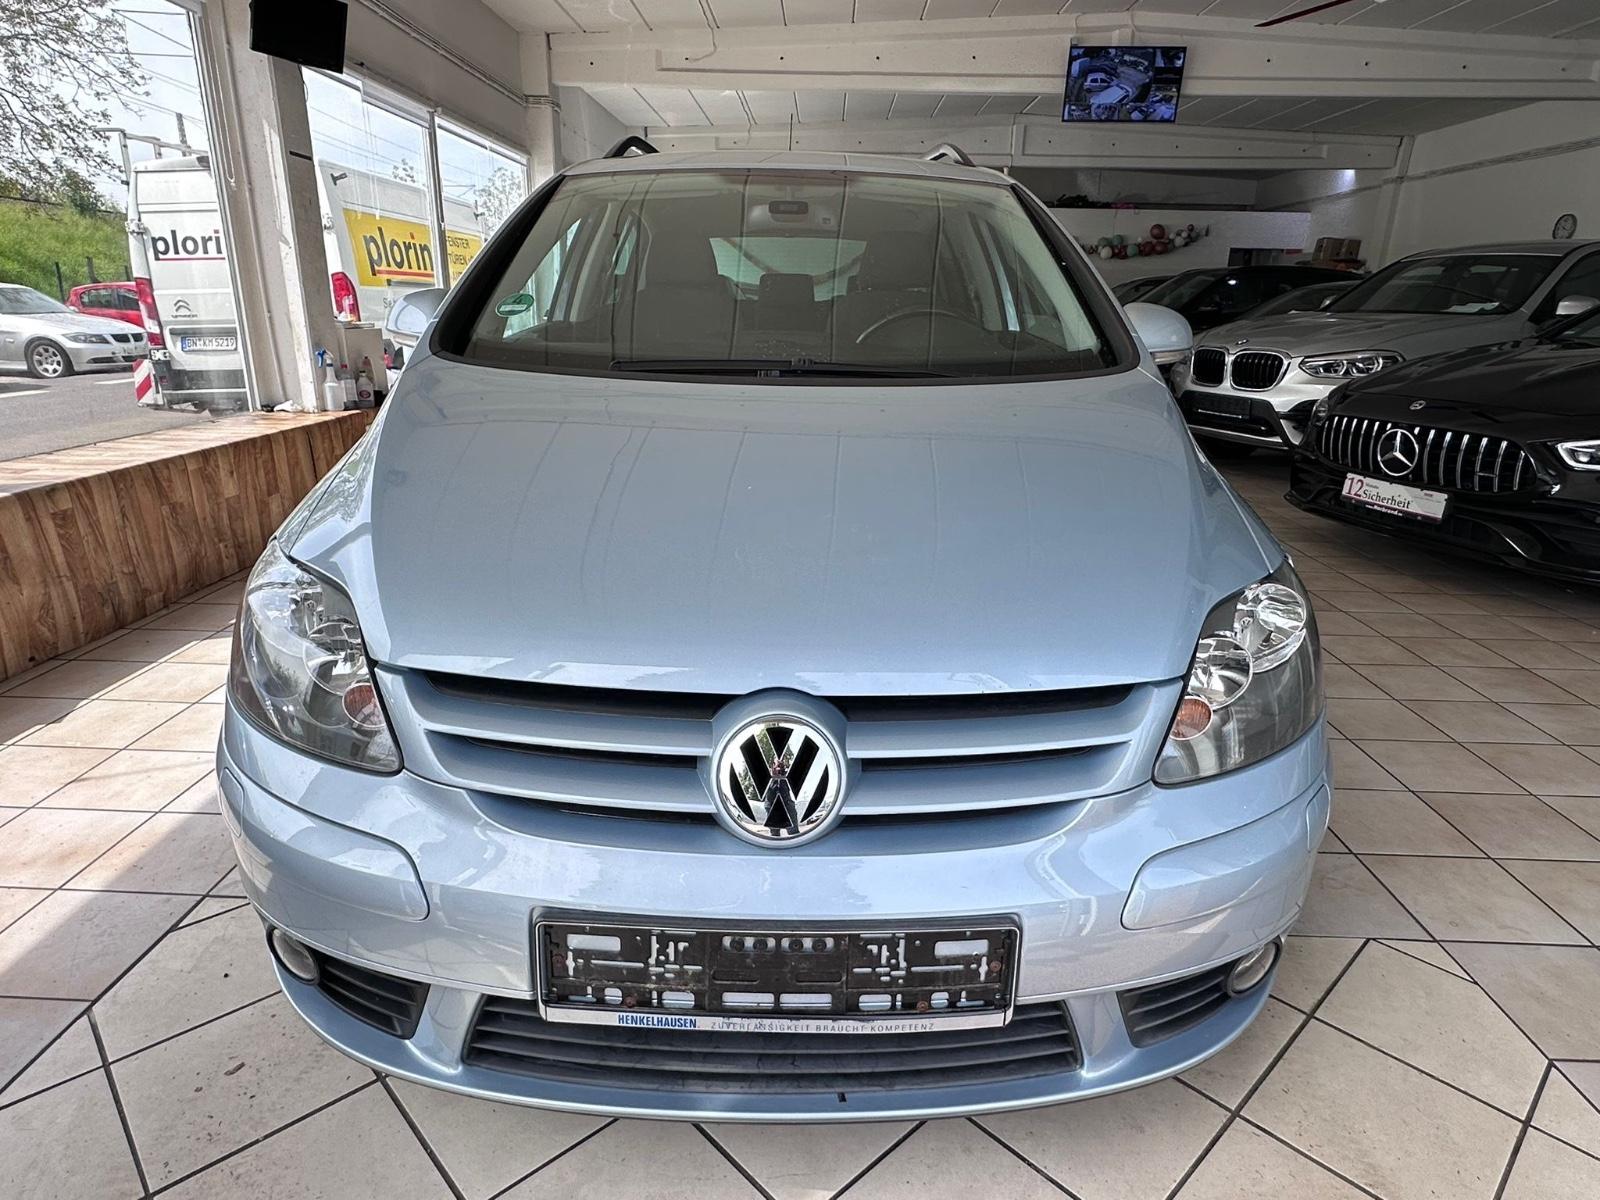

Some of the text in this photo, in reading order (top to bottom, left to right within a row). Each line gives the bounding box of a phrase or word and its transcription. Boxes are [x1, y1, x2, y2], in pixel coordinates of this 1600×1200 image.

[362, 226, 434, 276] plorin
[1345, 477, 1411, 509] 12 Sicherheit
[618, 1014, 697, 1029] HENKELHAUSEN
[870, 1022, 935, 1033] KOMPETENZ
